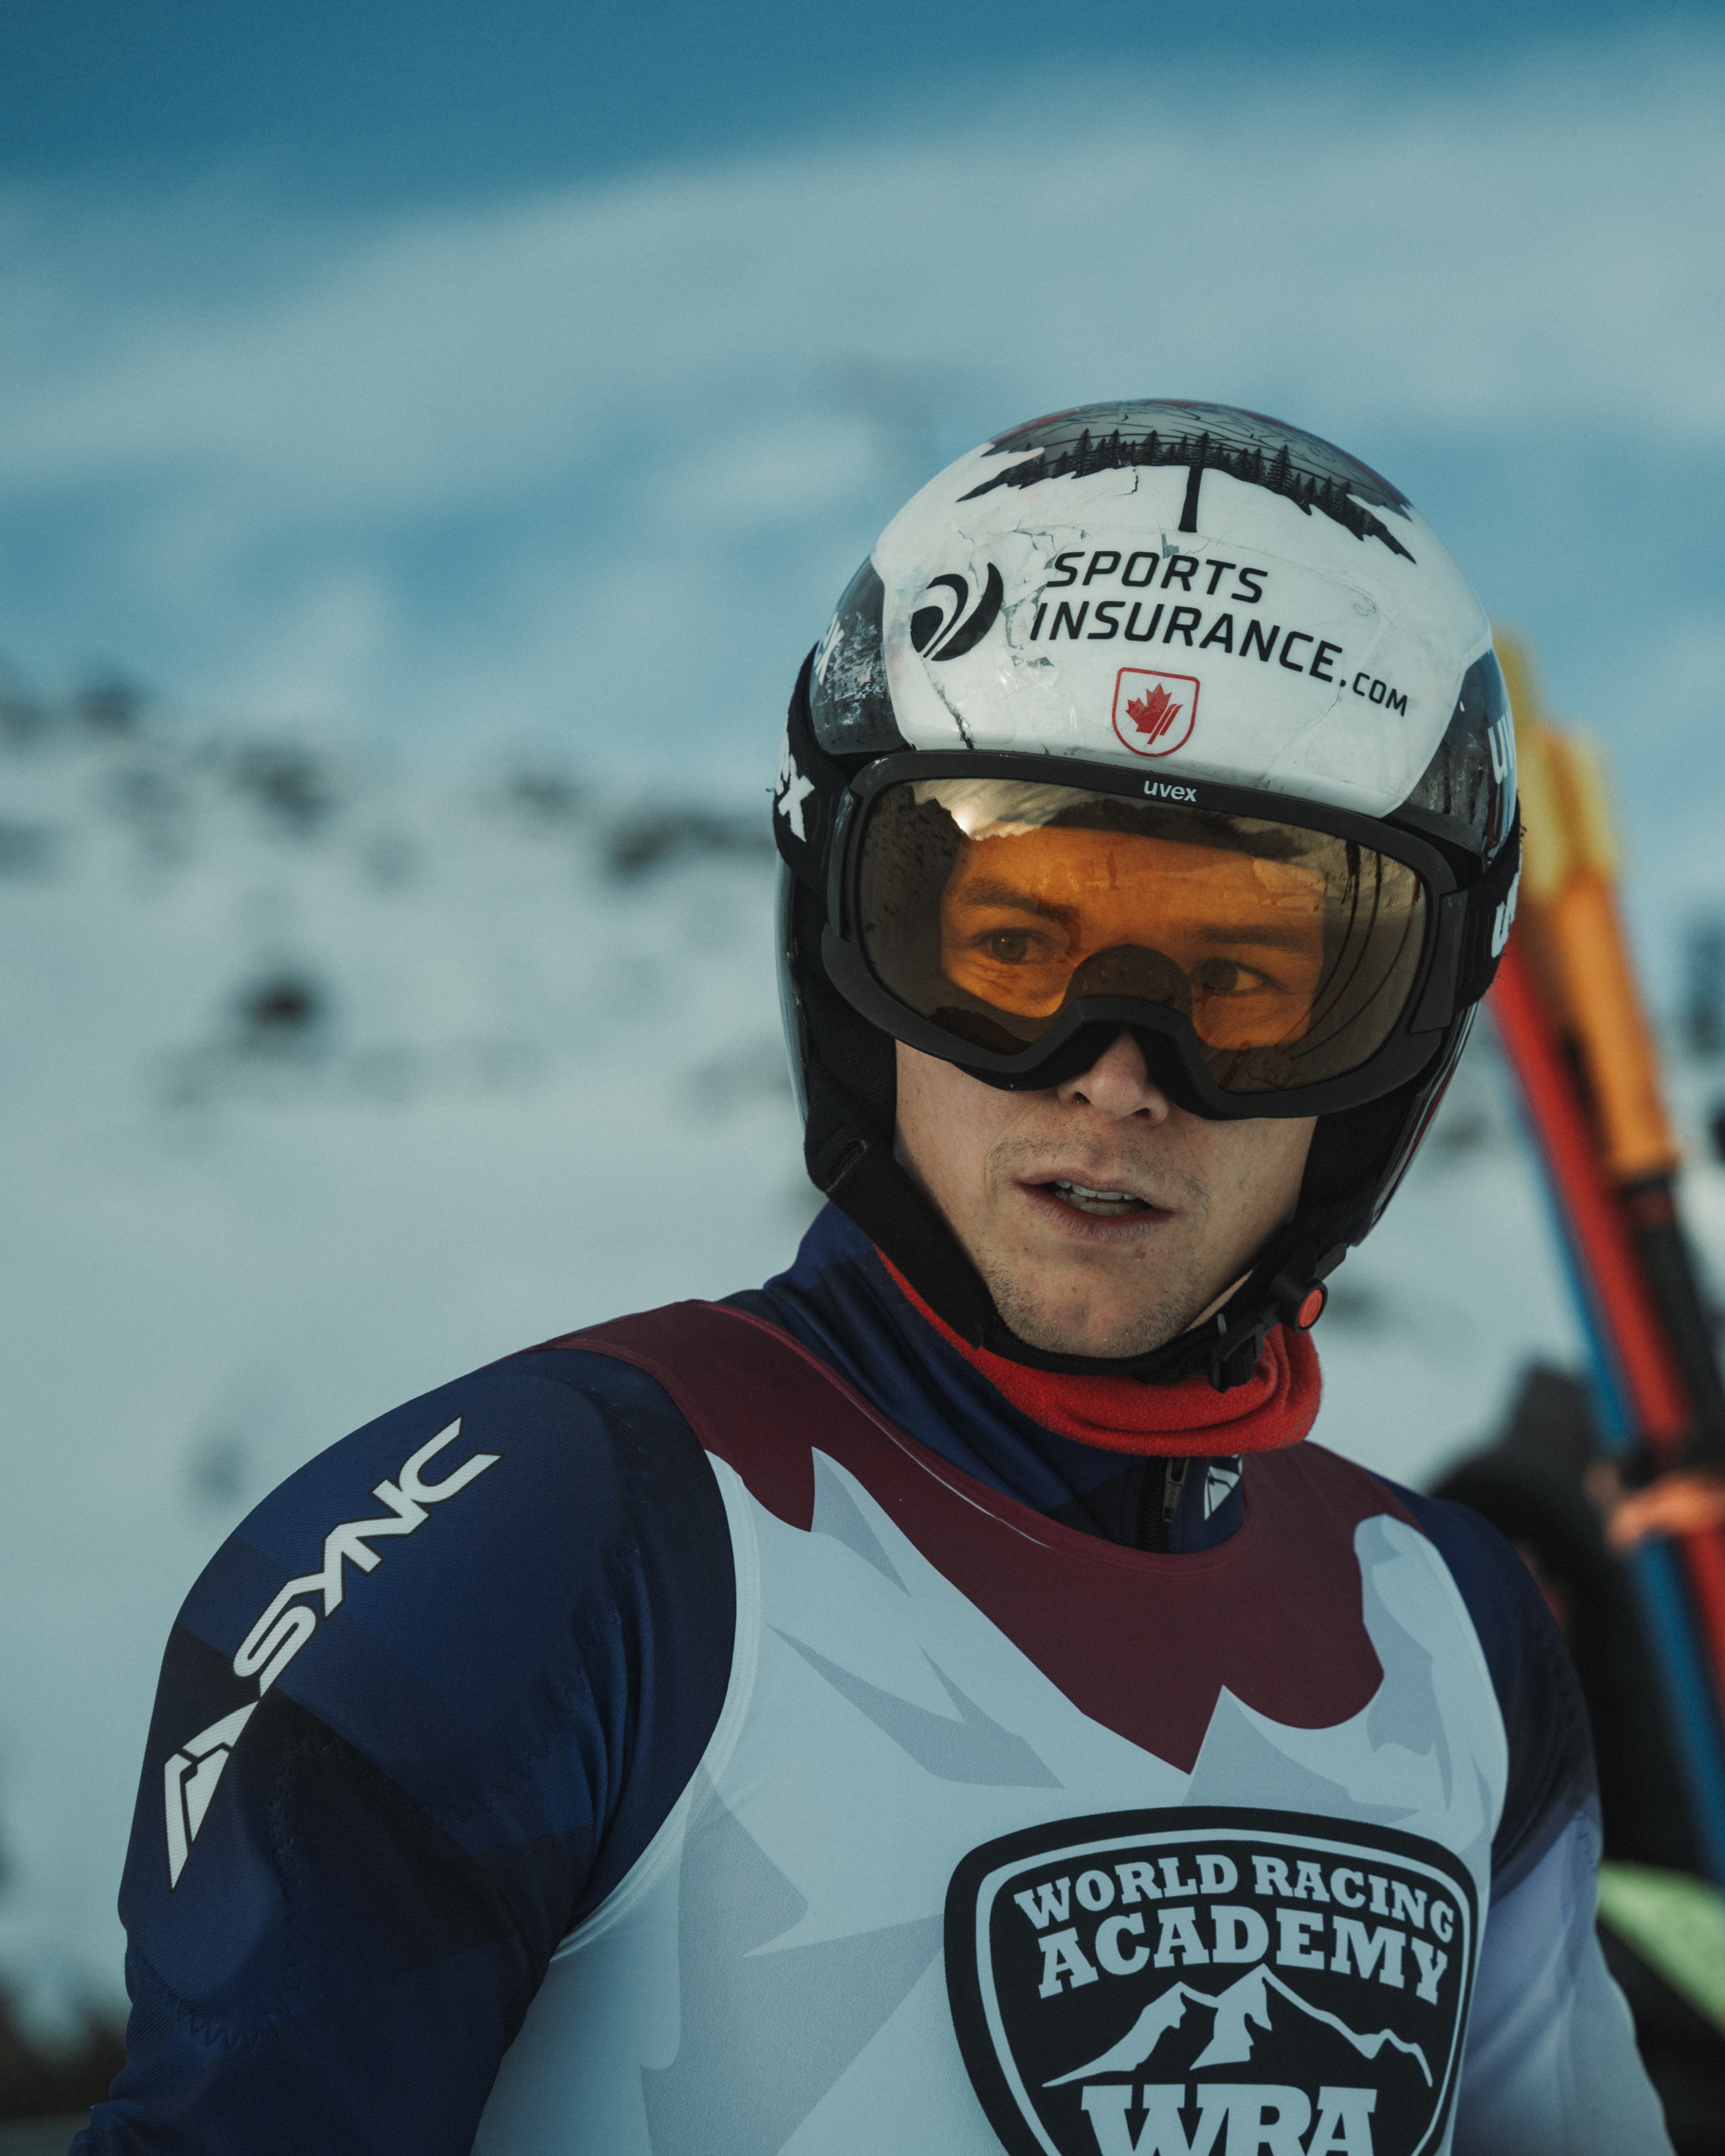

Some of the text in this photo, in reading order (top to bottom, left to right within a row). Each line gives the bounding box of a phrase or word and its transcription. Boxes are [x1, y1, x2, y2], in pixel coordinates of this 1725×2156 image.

[1046, 551, 1268, 604] SPORTS
[1143, 780, 1197, 803] uvex
[233, 1414, 505, 1698] SYNC
[1013, 1854, 1454, 1943] WORLD RACING
[1038, 1905, 1448, 2005] ACADEMY
[1081, 2083, 1377, 2156] WRA
